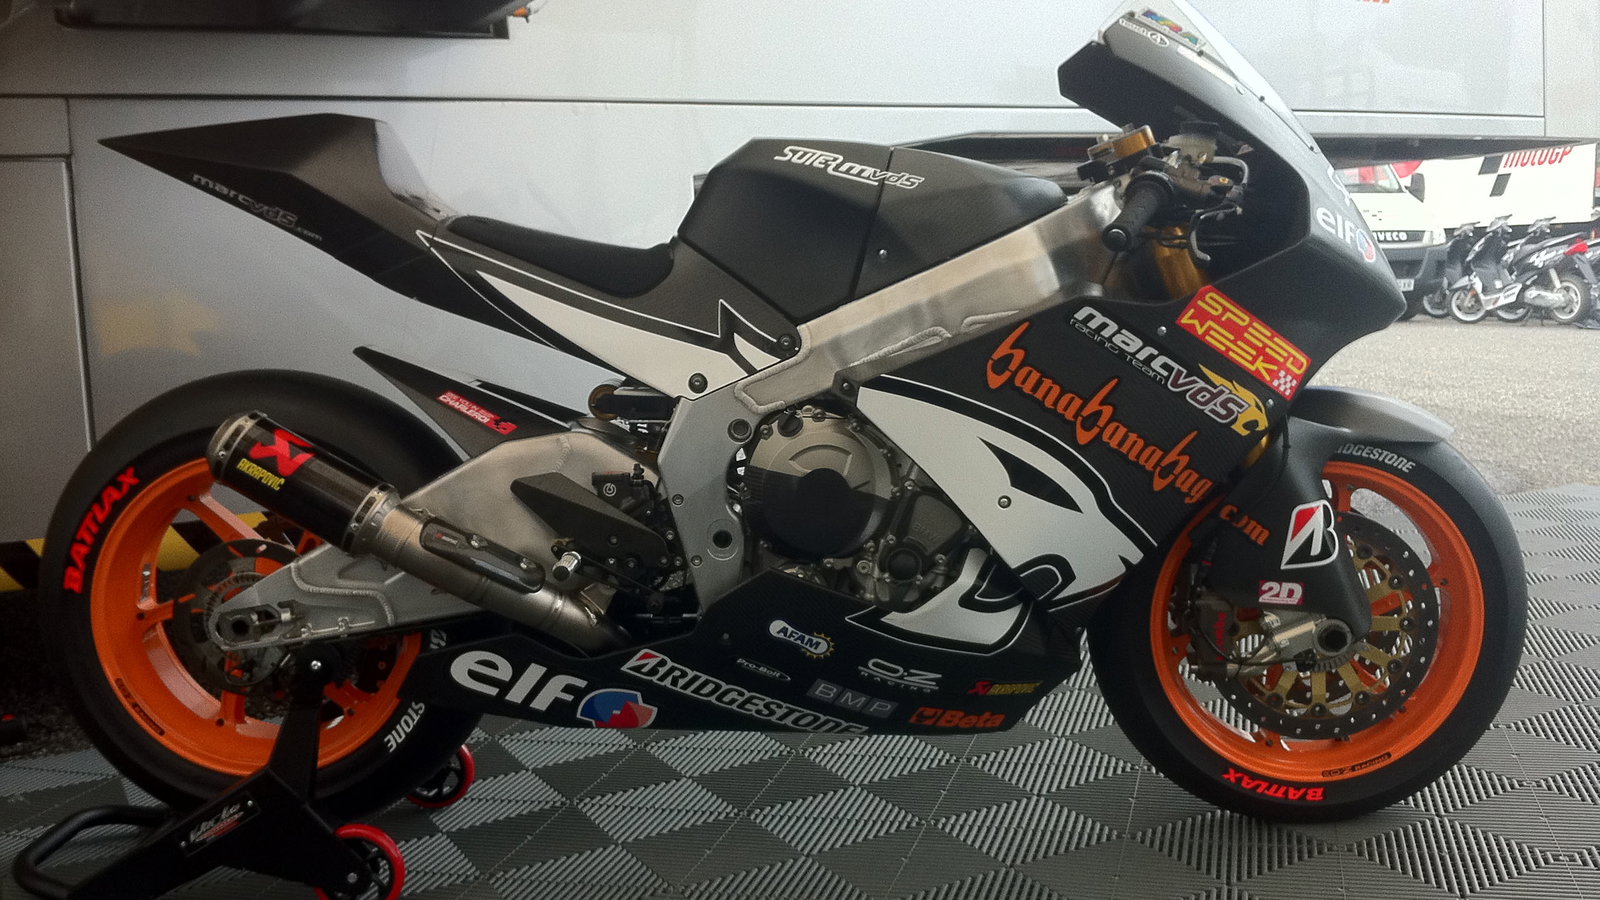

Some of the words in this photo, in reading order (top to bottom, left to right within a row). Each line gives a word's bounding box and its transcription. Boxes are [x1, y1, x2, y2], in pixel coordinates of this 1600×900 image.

[1315, 207, 1356, 243] elf
[1180, 308, 1278, 382] WEEK
[1197, 291, 1307, 375] SPEED
[986, 321, 1213, 504] banabanabag
[63, 466, 140, 594] BATTLAX
[776, 625, 822, 651] AFAM
[450, 650, 588, 713] elf
[621, 648, 869, 733] BRIDGESTONE
[814, 681, 892, 714] BMP
[936, 709, 1006, 728] Beta
[1222, 767, 1326, 801] BATTLAX
